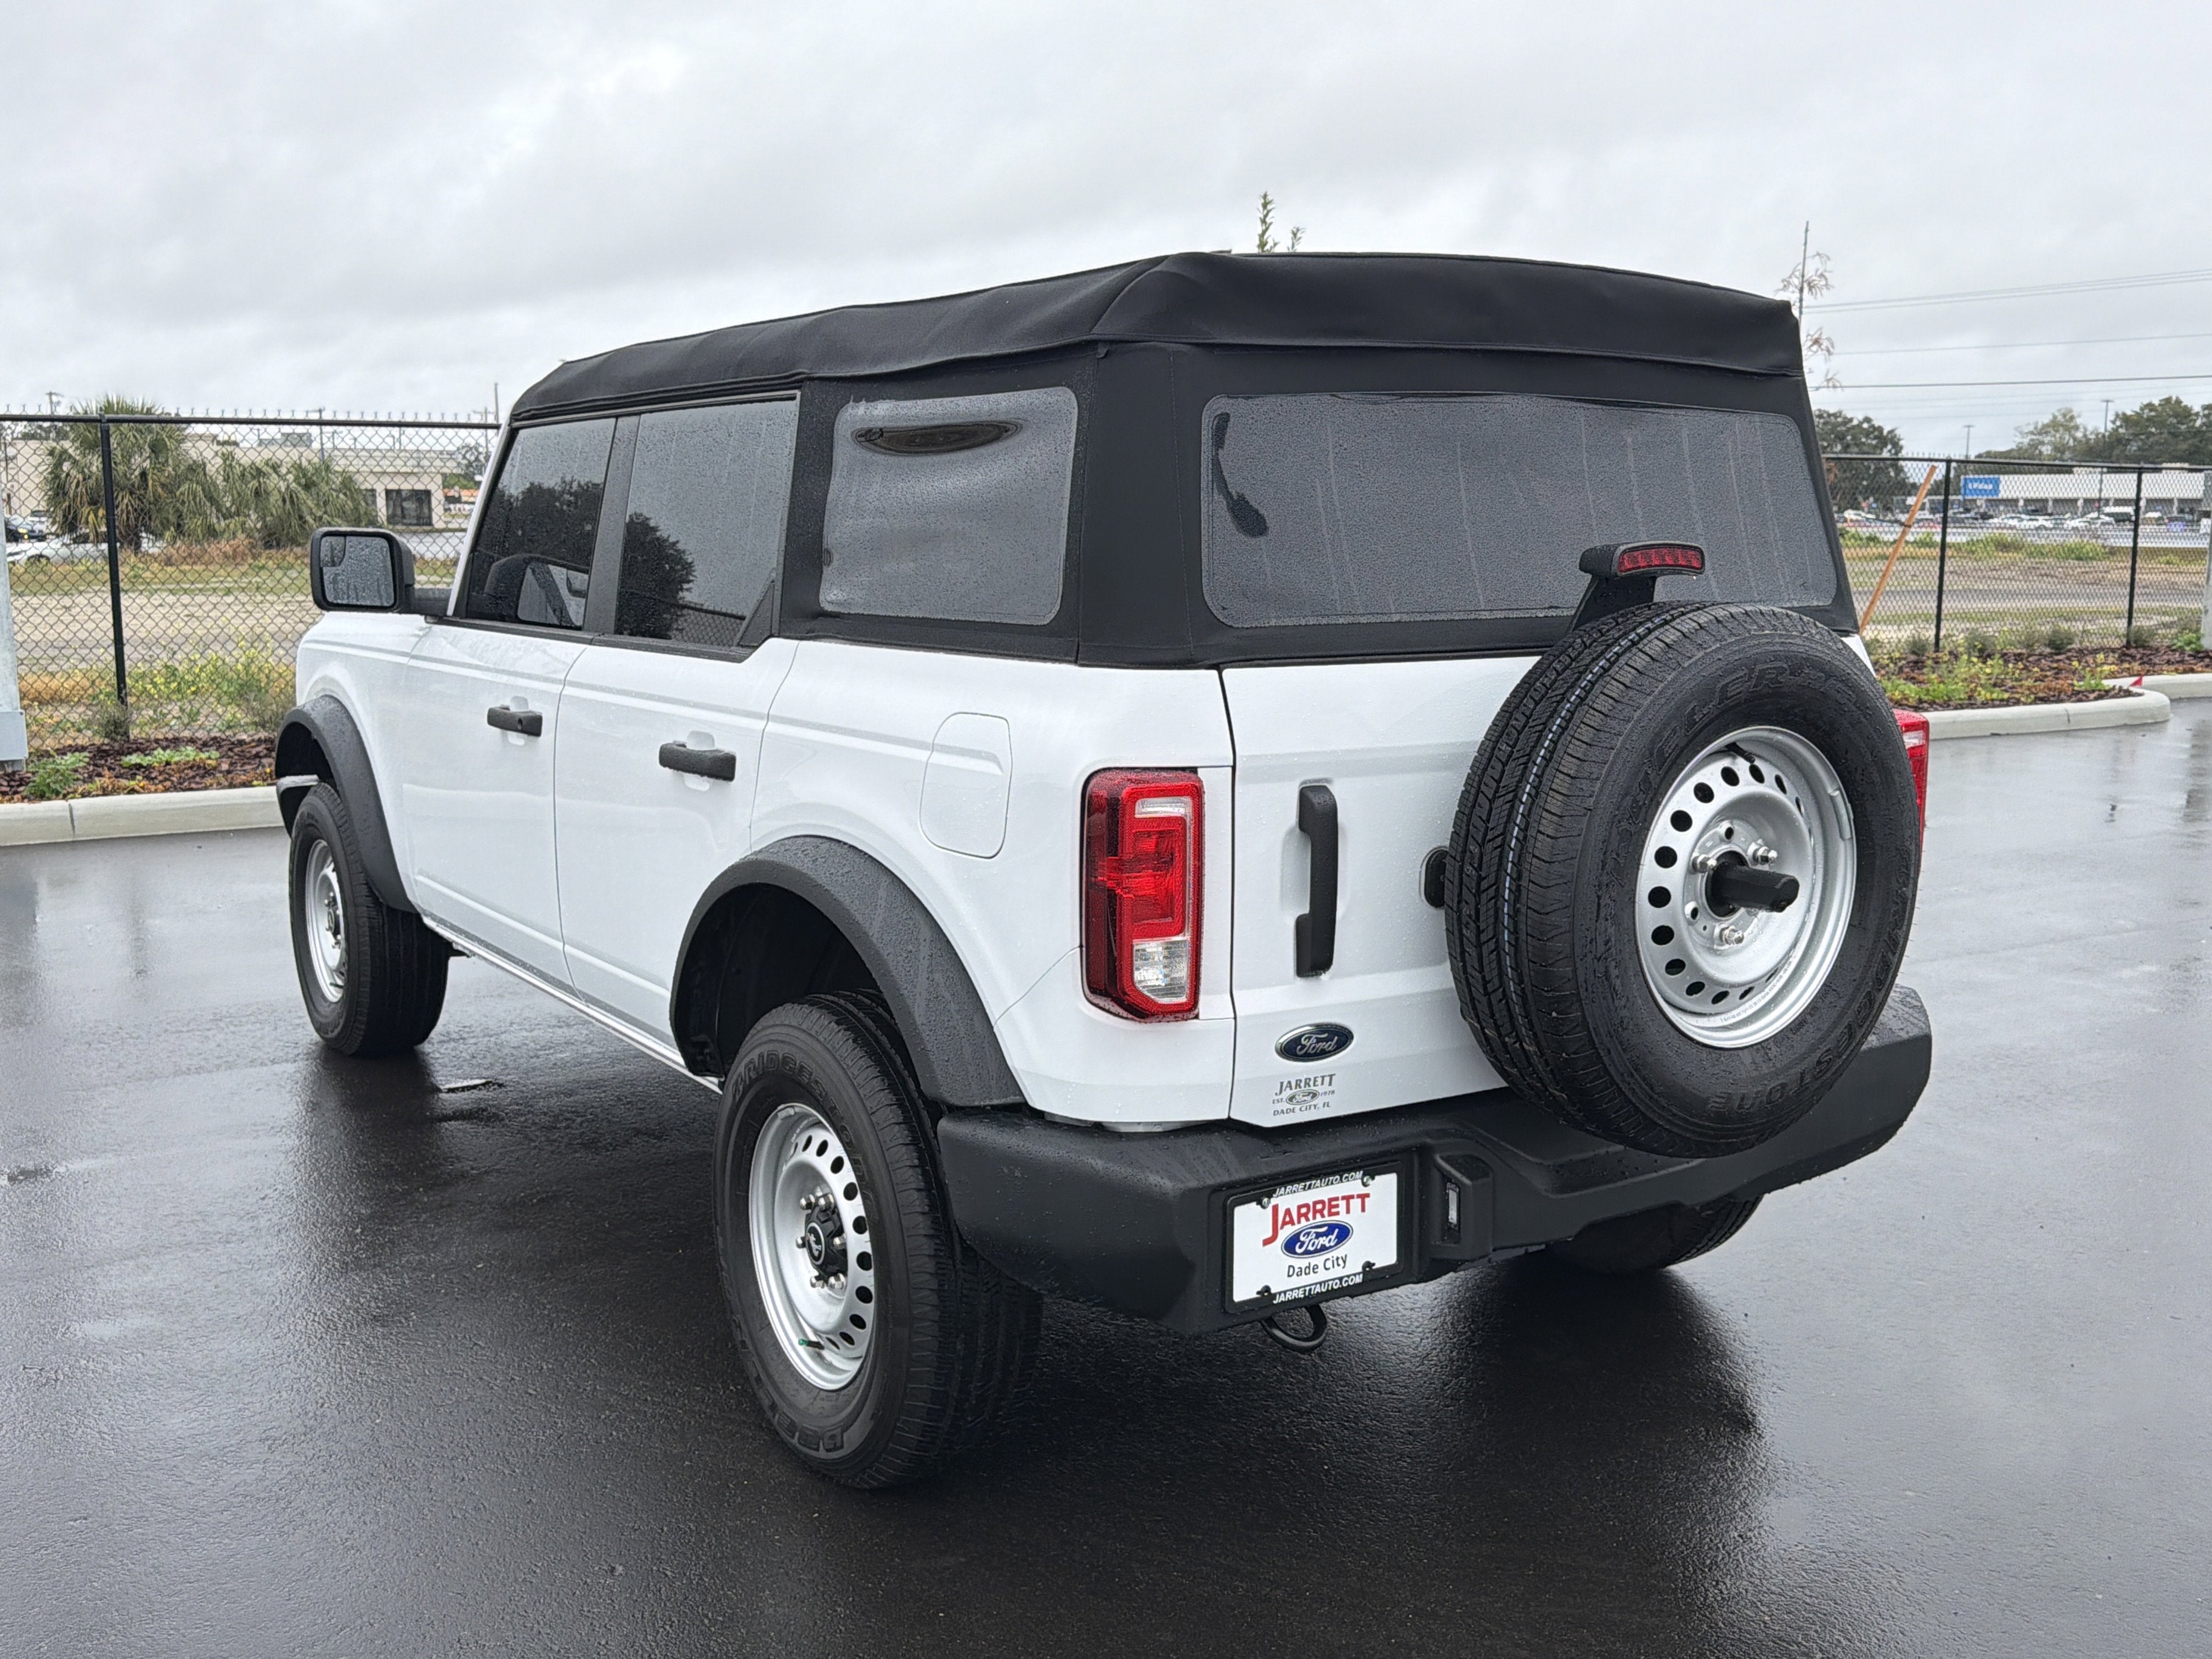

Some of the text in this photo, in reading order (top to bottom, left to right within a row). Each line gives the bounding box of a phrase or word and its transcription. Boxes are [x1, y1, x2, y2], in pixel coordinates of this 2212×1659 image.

[1296, 1033, 1338, 1056] Ford
[1275, 1073, 1336, 1096] JARRETT
[1273, 1107, 1296, 1116] DADE
[1299, 1103, 1320, 1112] CITY,
[1273, 1170, 1363, 1197] JARRETTAUTO.COM
[1262, 1193, 1370, 1246] JARRETT
[1295, 1226, 1339, 1254] Ford
[1287, 1254, 1347, 1277] Dade City
[1273, 1273, 1363, 1304] JARRETTAUTO.COM
